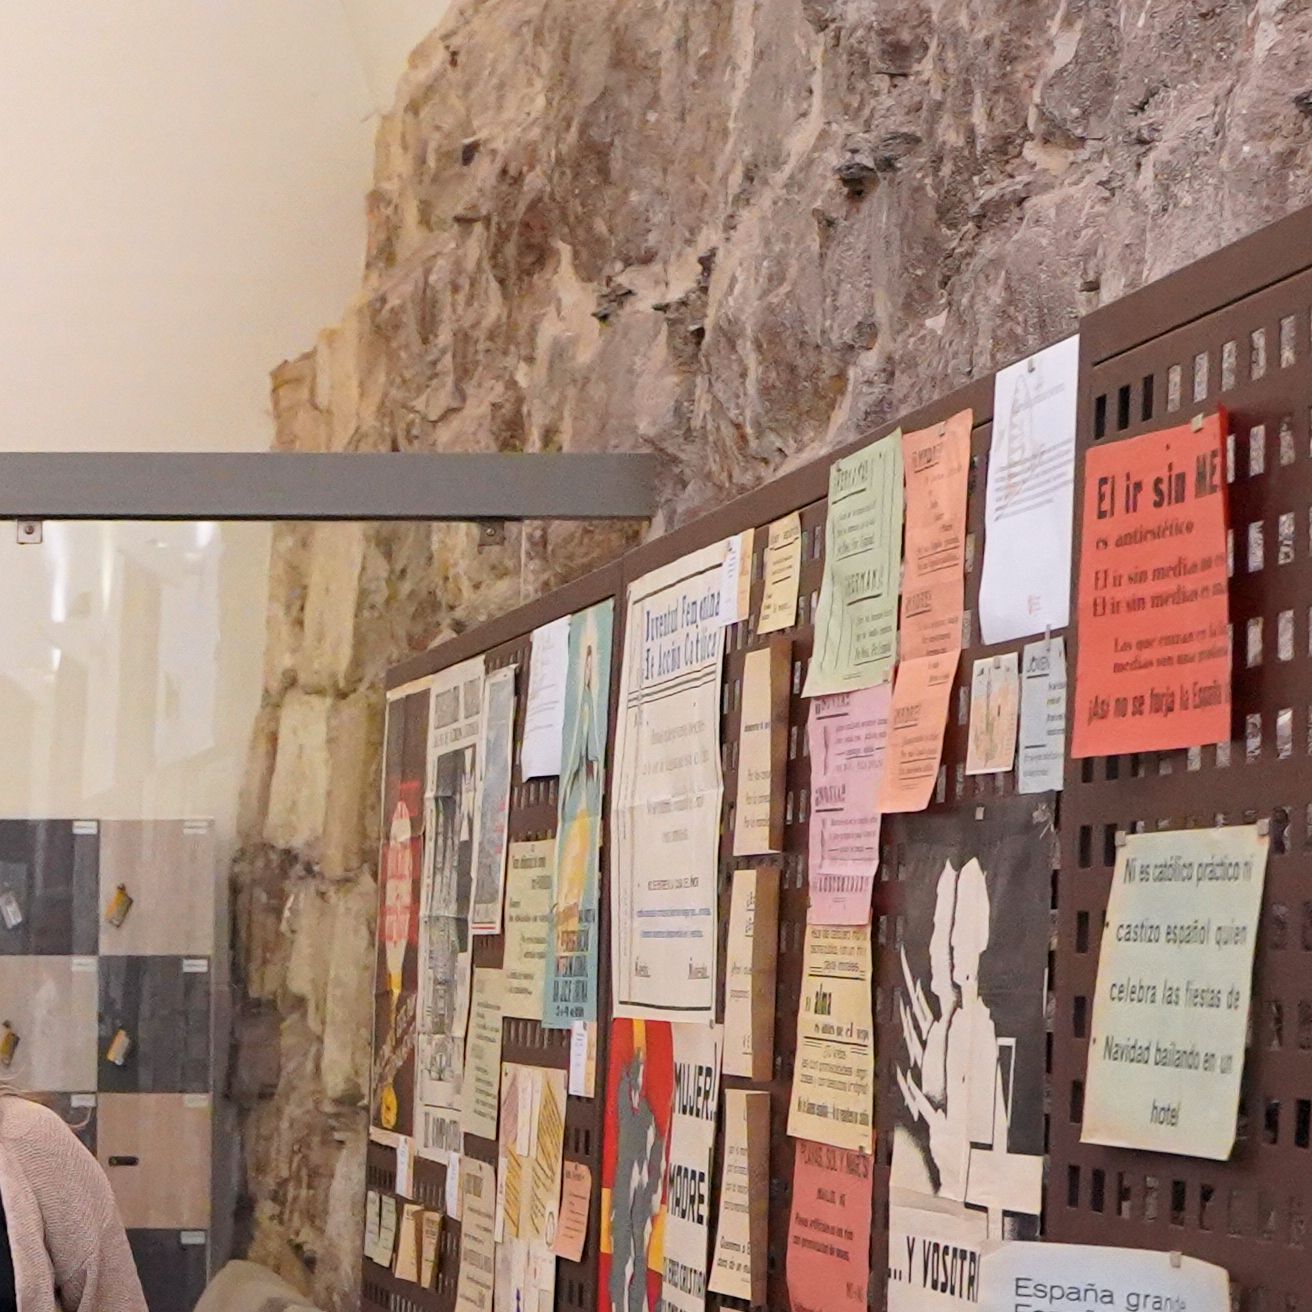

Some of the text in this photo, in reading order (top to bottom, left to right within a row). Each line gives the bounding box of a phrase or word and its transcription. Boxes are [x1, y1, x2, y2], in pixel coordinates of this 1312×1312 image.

[1097, 475, 1114, 520] El
[1125, 472, 1142, 514] ir
[1152, 462, 1186, 508] sin
[1094, 569, 1108, 591] El
[1093, 596, 1106, 617] El
[1131, 694, 1145, 716] se
[1149, 686, 1175, 718] forja
[1123, 855, 1253, 887] Ni es católico práctico ni
[1116, 918, 1248, 949] castizo español quien
[1109, 977, 1240, 1011] celebra las fiestas de
[1103, 1035, 1233, 1074] Navidad bailando en un
[1150, 1099, 1181, 1127] hotel
[1015, 1277, 1114, 1305] España
